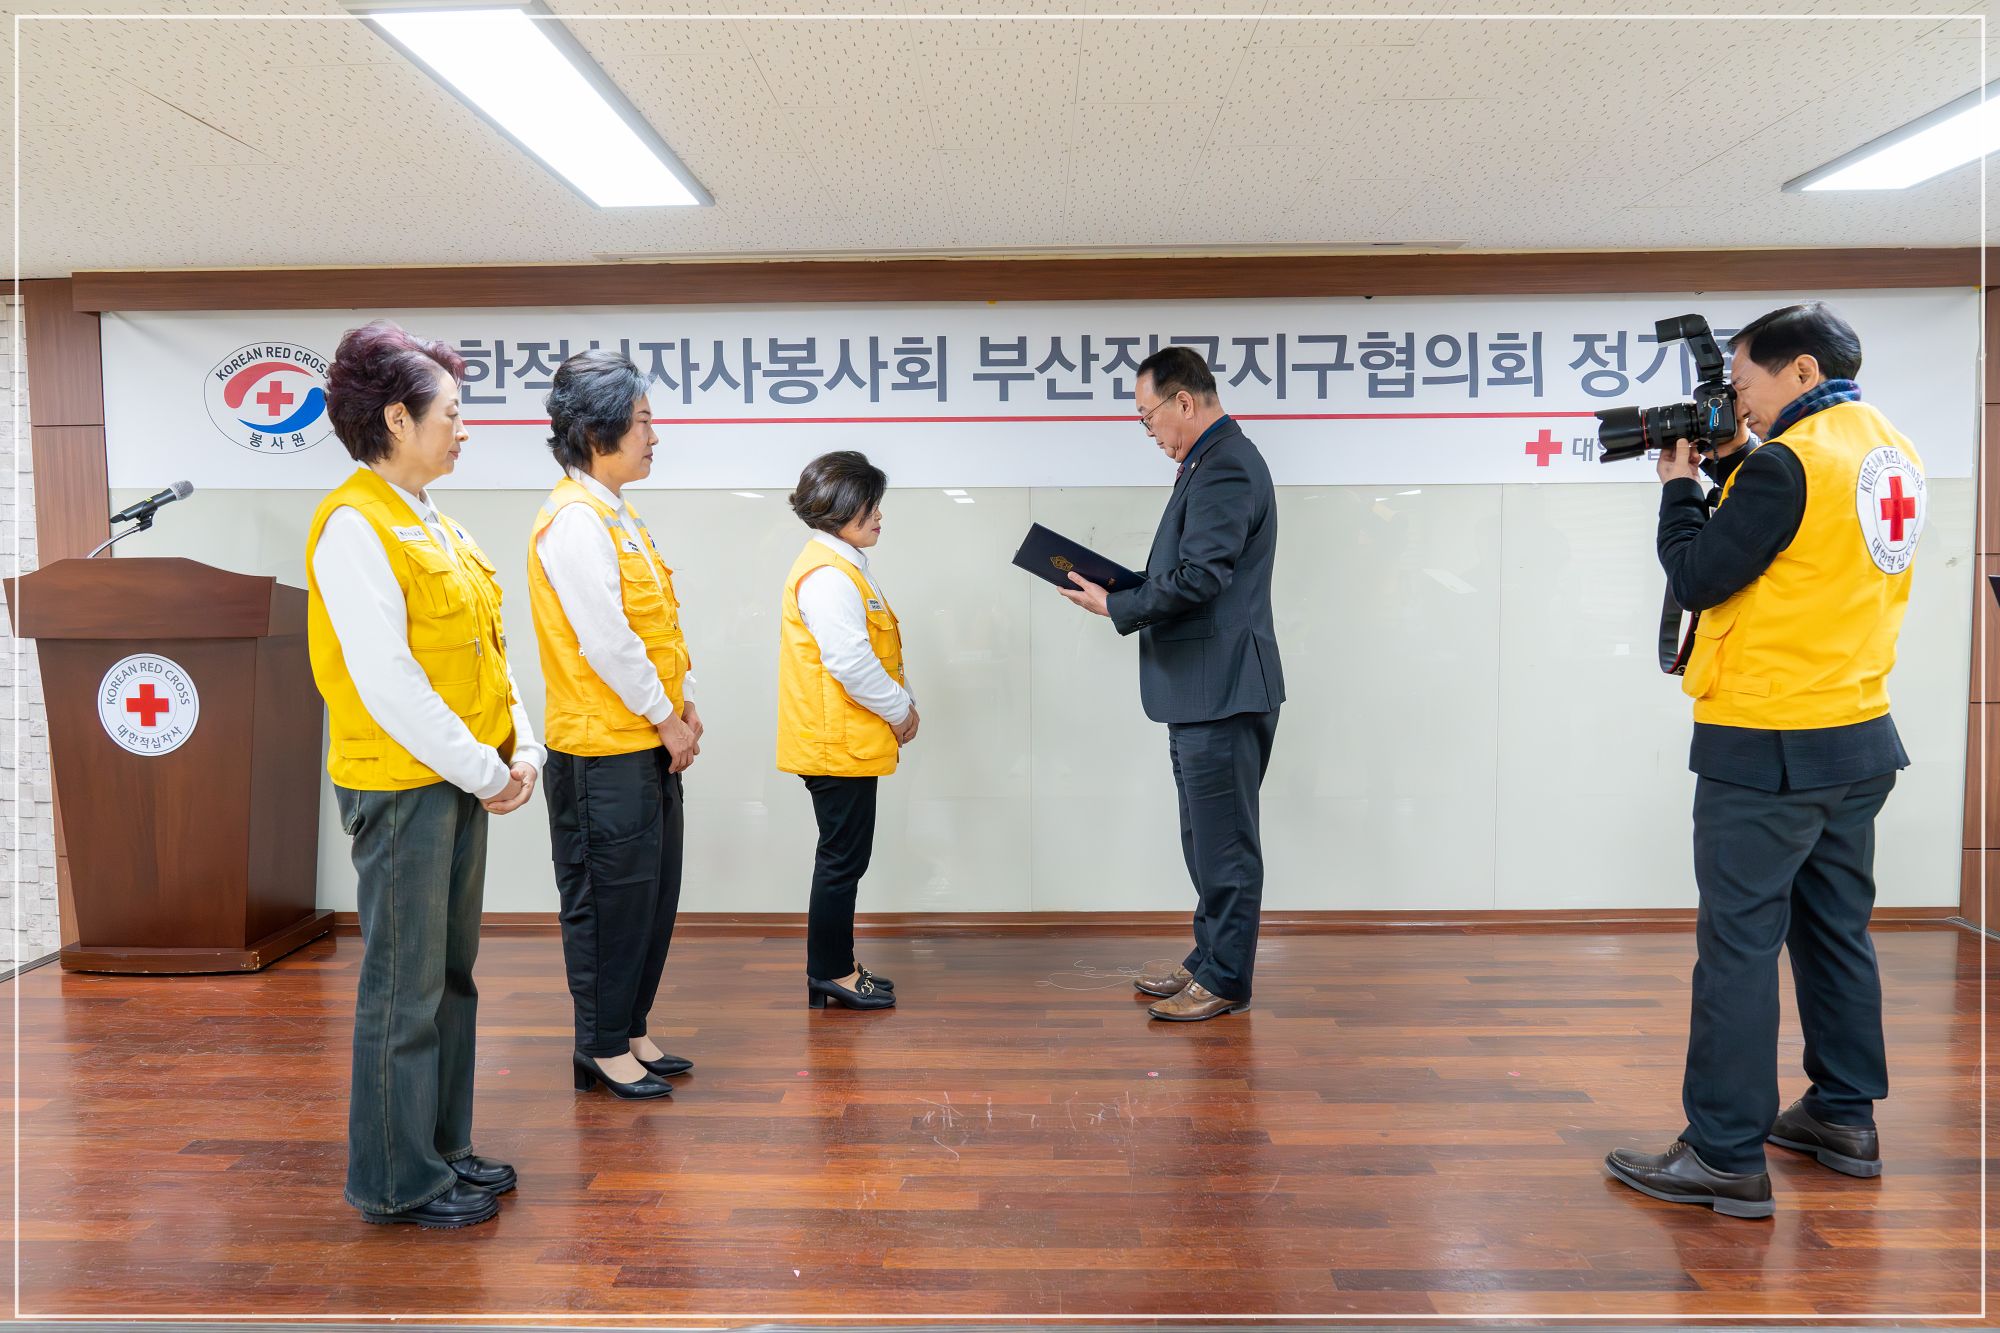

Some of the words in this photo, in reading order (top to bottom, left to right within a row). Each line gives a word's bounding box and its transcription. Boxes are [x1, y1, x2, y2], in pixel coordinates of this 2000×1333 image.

[216, 347, 263, 381] KOREAN
[266, 346, 291, 359] RED
[459, 335, 947, 405] 한적자사봉사회
[250, 432, 306, 450] 봉사원
[1860, 453, 1883, 494] KOREAN
[106, 664, 137, 705] KOREAN
[140, 662, 163, 674] RED
[164, 670, 191, 705] CROSS
[117, 724, 183, 749] 대한적십자사
